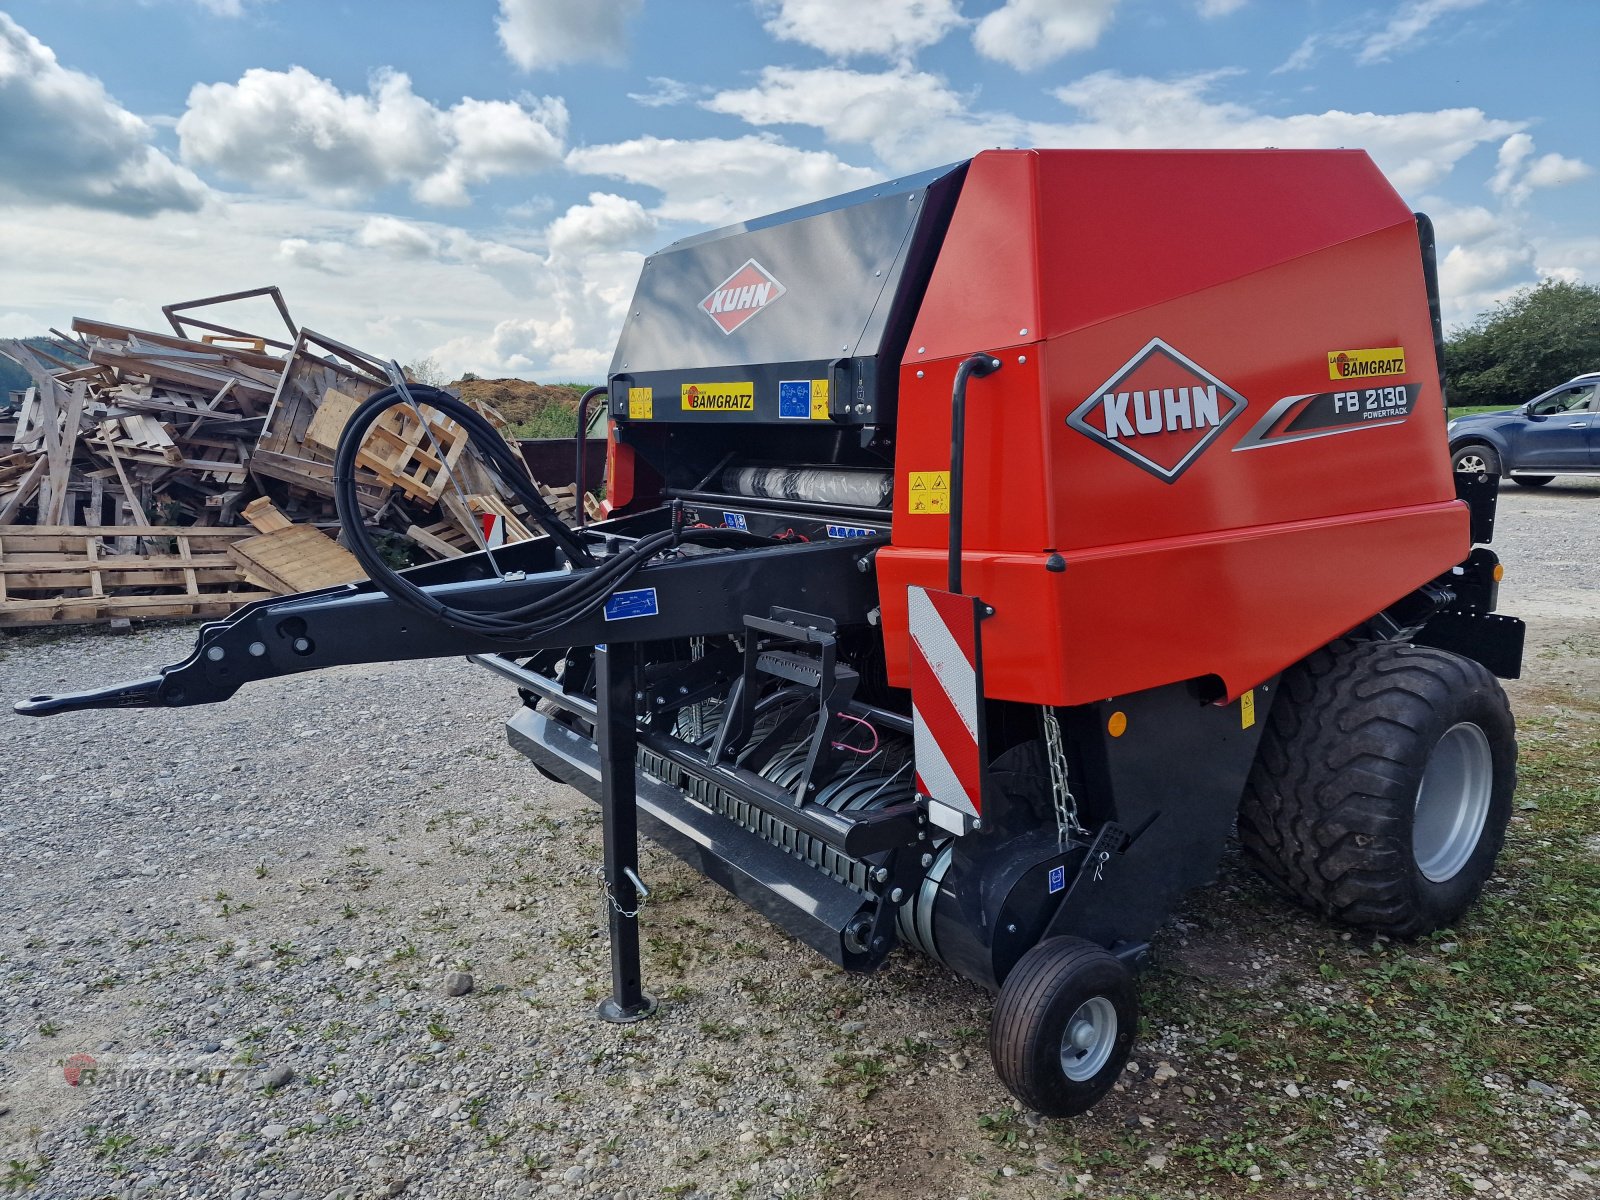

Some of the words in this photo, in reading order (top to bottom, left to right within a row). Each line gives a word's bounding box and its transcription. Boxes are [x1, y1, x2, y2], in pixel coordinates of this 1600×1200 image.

[709, 281, 772, 314] KUHN
[1342, 358, 1404, 377] BAMGRATZ
[692, 394, 752, 409] BAMGRATZ
[1333, 391, 1360, 414] FB
[1365, 386, 1407, 410] 2130
[1103, 384, 1220, 440] KUHN
[1363, 407, 1408, 420] POWERTRACK
